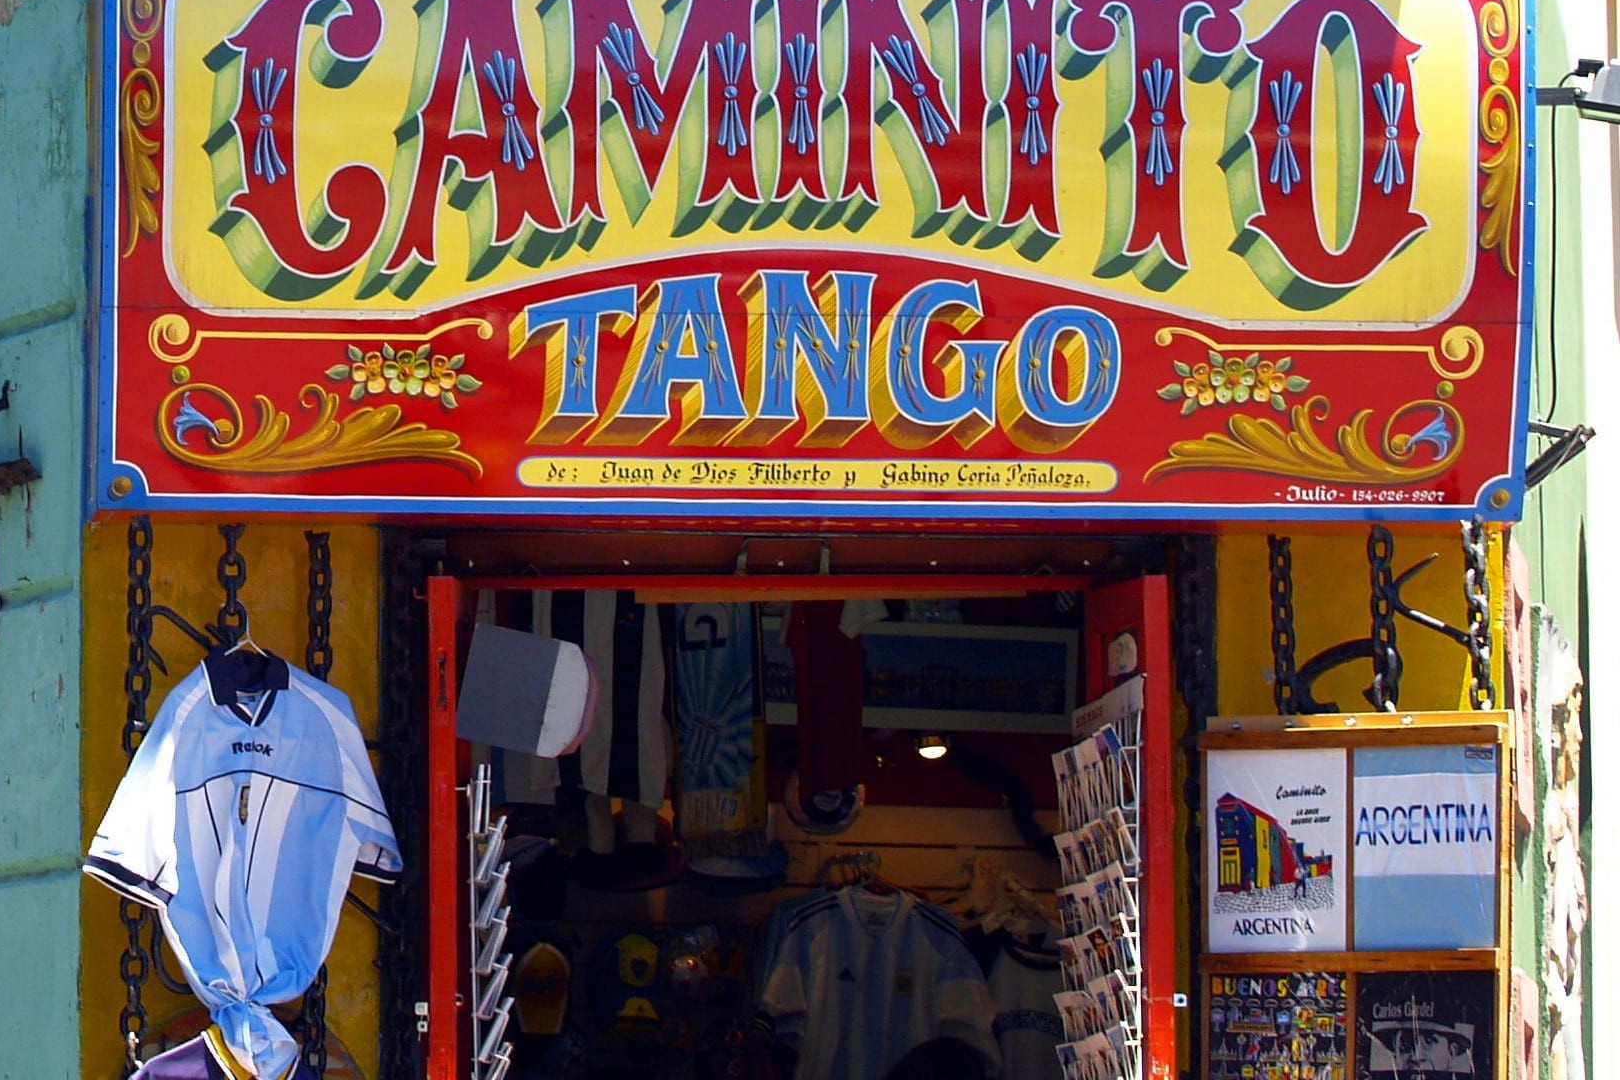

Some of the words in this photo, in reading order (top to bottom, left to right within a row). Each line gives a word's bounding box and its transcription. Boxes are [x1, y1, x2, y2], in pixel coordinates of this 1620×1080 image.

[517, 268, 1122, 438] TANGO
[600, 461, 654, 484] Juan
[661, 462, 681, 481] de
[690, 460, 737, 483] Dios
[747, 461, 830, 485] Filiberto
[843, 470, 857, 489] y
[880, 463, 950, 487] Gabino
[956, 464, 1001, 486] Coria
[1352, 489, 1445, 502] 154-026-9907
[1275, 784, 1327, 801] Caminito
[1355, 803, 1493, 847] ARGENTINA
[1232, 917, 1315, 937] ARGENTINA
[1211, 977, 1288, 998] BUENOS
[1372, 1002, 1402, 1020] Carlos
